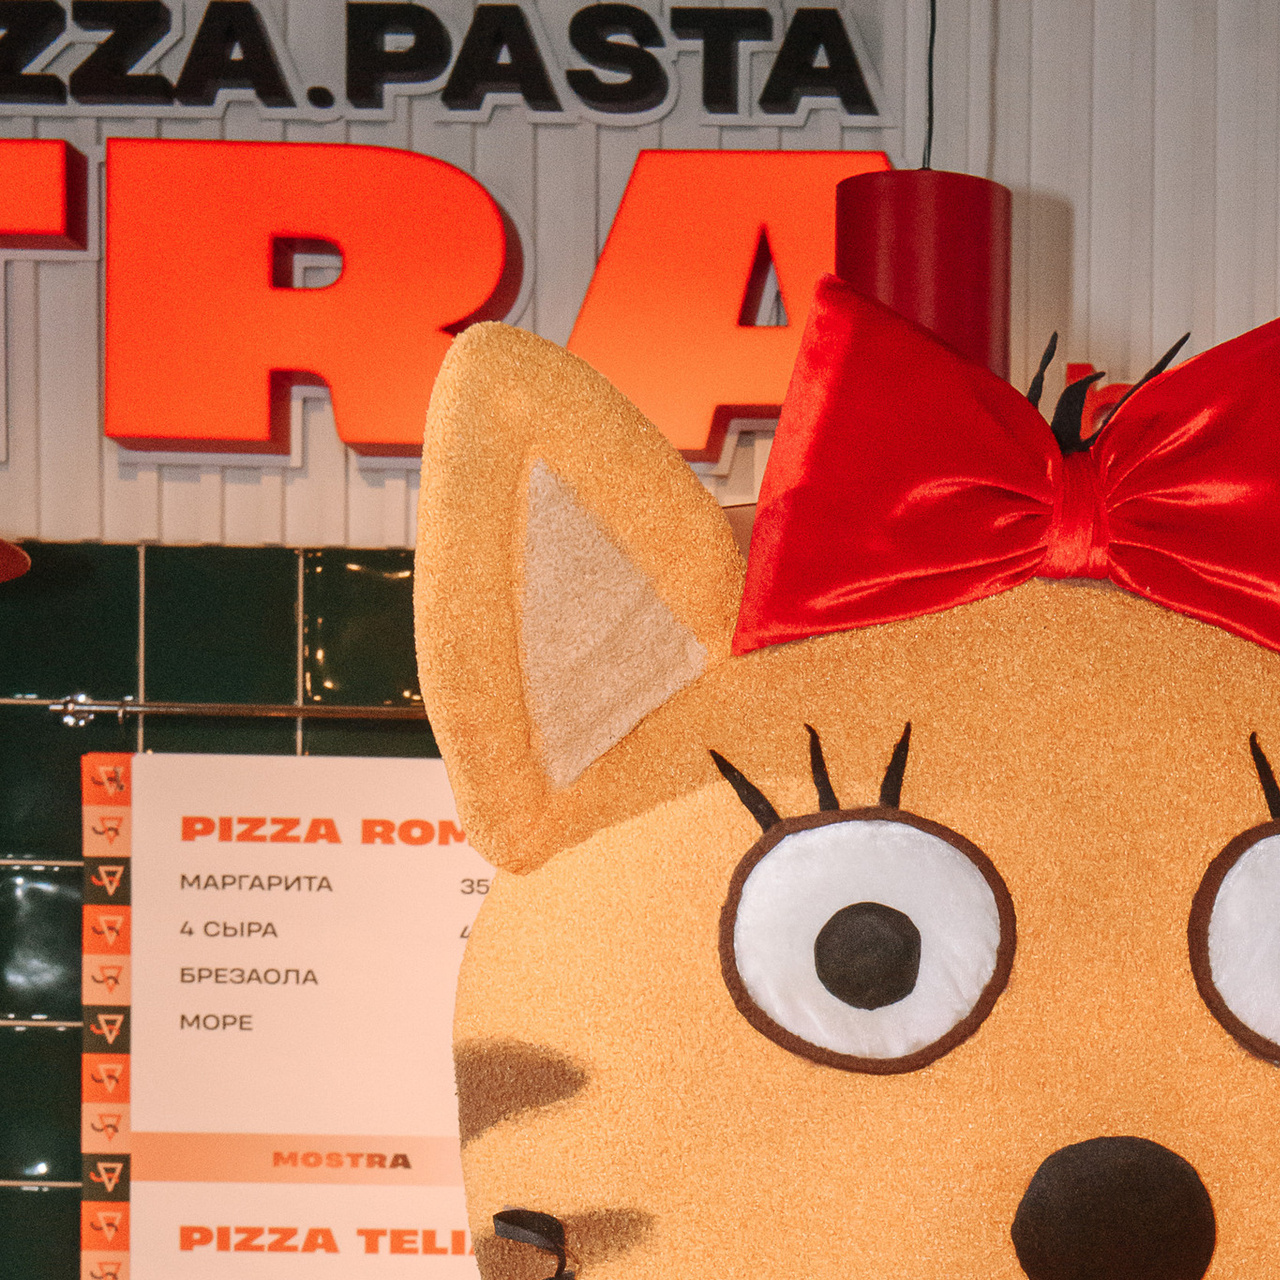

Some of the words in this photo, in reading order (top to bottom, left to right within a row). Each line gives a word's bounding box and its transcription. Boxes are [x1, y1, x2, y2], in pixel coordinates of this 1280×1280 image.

[0, 137, 893, 458] RA
[181, 816, 342, 844] PIZZA
[180, 873, 334, 892] МАРГАРИТА
[179, 921, 195, 936] 4
[203, 921, 279, 938] СЫРА
[180, 967, 319, 986] БРЕЗАОЛА
[180, 1014, 254, 1031] МОРЕ
[272, 1151, 412, 1169] MOSTRA
[179, 1226, 341, 1254] PIZZA
[356, 1228, 477, 1256] TELI
